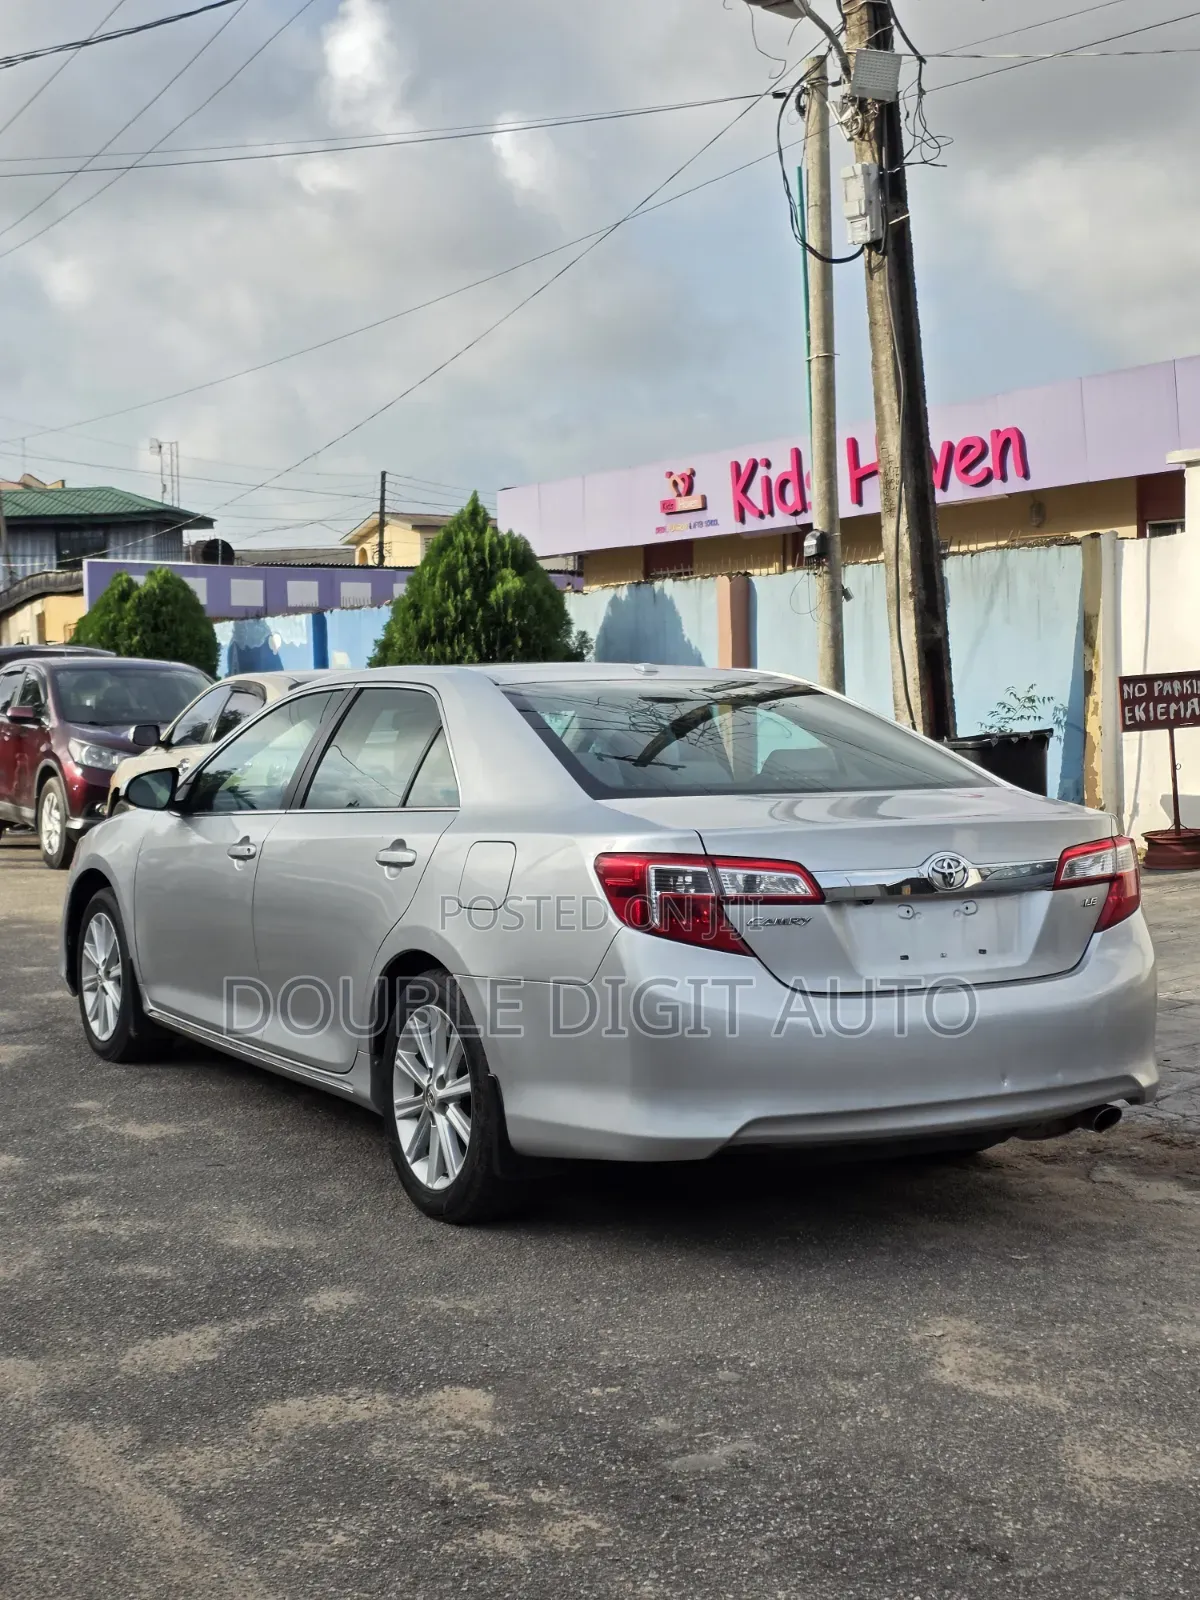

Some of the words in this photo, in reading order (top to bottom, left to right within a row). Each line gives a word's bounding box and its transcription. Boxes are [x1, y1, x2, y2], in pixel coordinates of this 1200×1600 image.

[846, 427, 1031, 507] Hven
[1122, 683, 1148, 699] NO
[1082, 896, 1098, 908] LE
[746, 916, 814, 927] CAMRY
